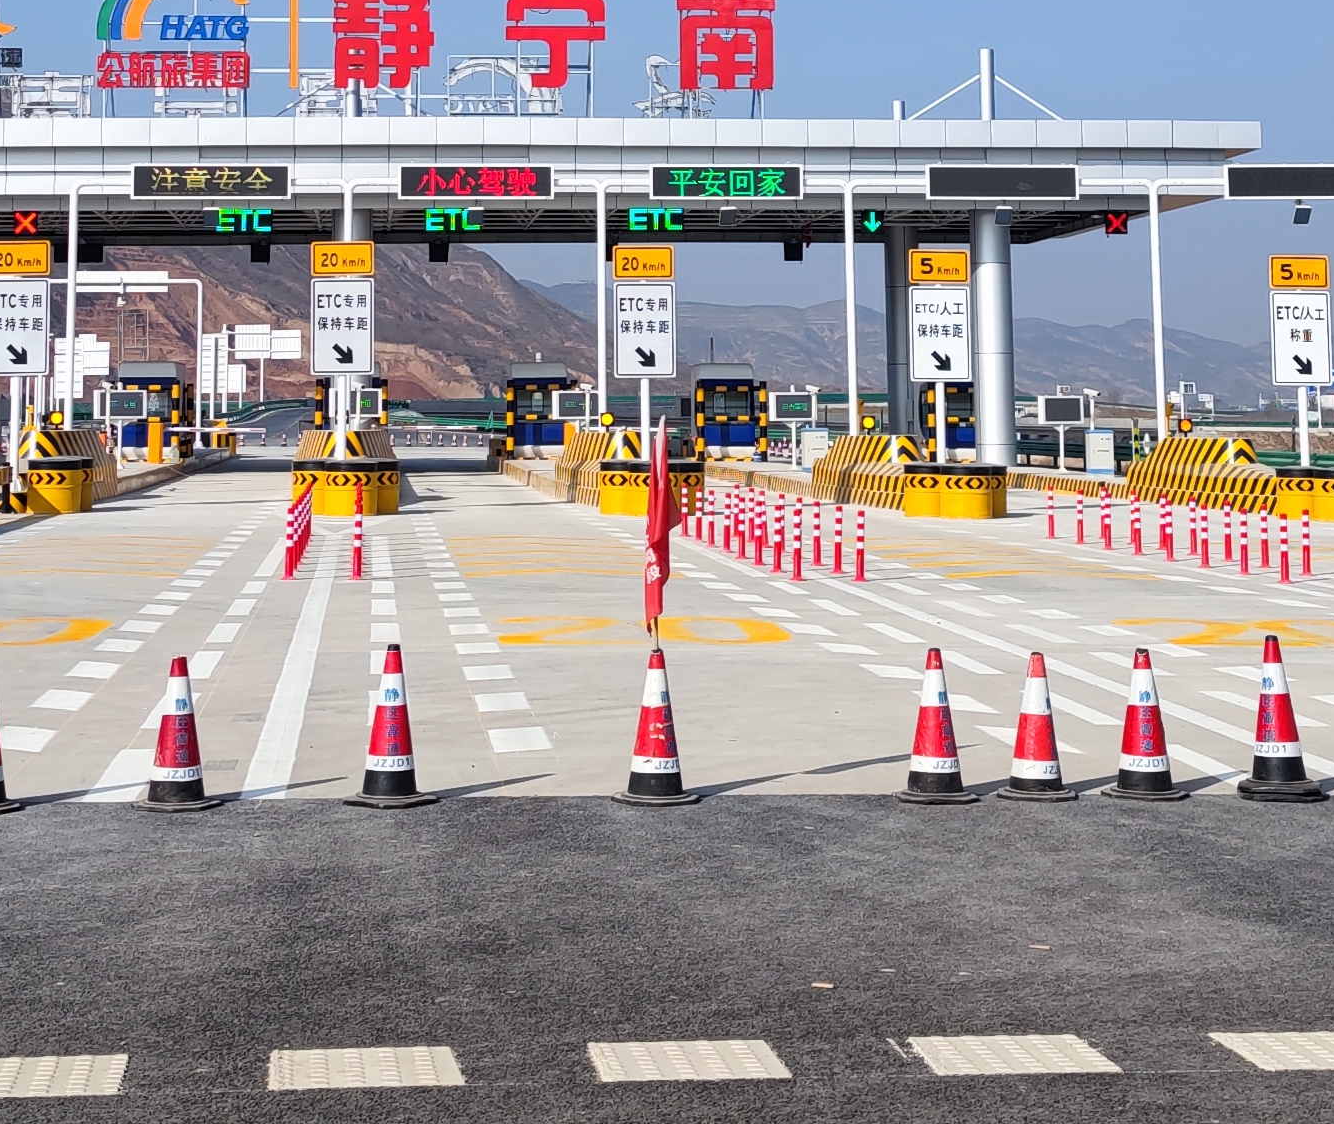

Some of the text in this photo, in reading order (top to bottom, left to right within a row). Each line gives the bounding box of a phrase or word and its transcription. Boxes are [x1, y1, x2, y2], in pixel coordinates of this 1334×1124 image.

[160, 15, 250, 41] HATG
[97, 51, 251, 88] 公航旅集团
[151, 167, 273, 193] 注意安全
[415, 167, 538, 196] 小心驾驶
[668, 169, 786, 197] 平安回家
[215, 208, 272, 232] ETC
[425, 207, 481, 232] ETC
[629, 208, 684, 231] ETC
[321, 252, 339, 267] 20
[621, 257, 639, 271] 20
[920, 258, 934, 275] 5
[1280, 263, 1294, 280] 5
[317, 294, 367, 308] ETC专用
[619, 297, 668, 312] ETC专用
[915, 302, 964, 316] ETC/人工
[1276, 306, 1325, 320] ETC/人工
[318, 317, 368, 331] 保持车距
[620, 320, 669, 334] 保持车距
[917, 324, 964, 338] 保持车距
[1290, 328, 1313, 342] 称重
[496, 616, 793, 644] 20
[1254, 744, 1287, 754] JZJD1
[373, 757, 411, 768] JZJD1
[933, 759, 959, 770] JZJD
[1128, 757, 1166, 768] JZJD1
[163, 768, 201, 779] JZJD1
